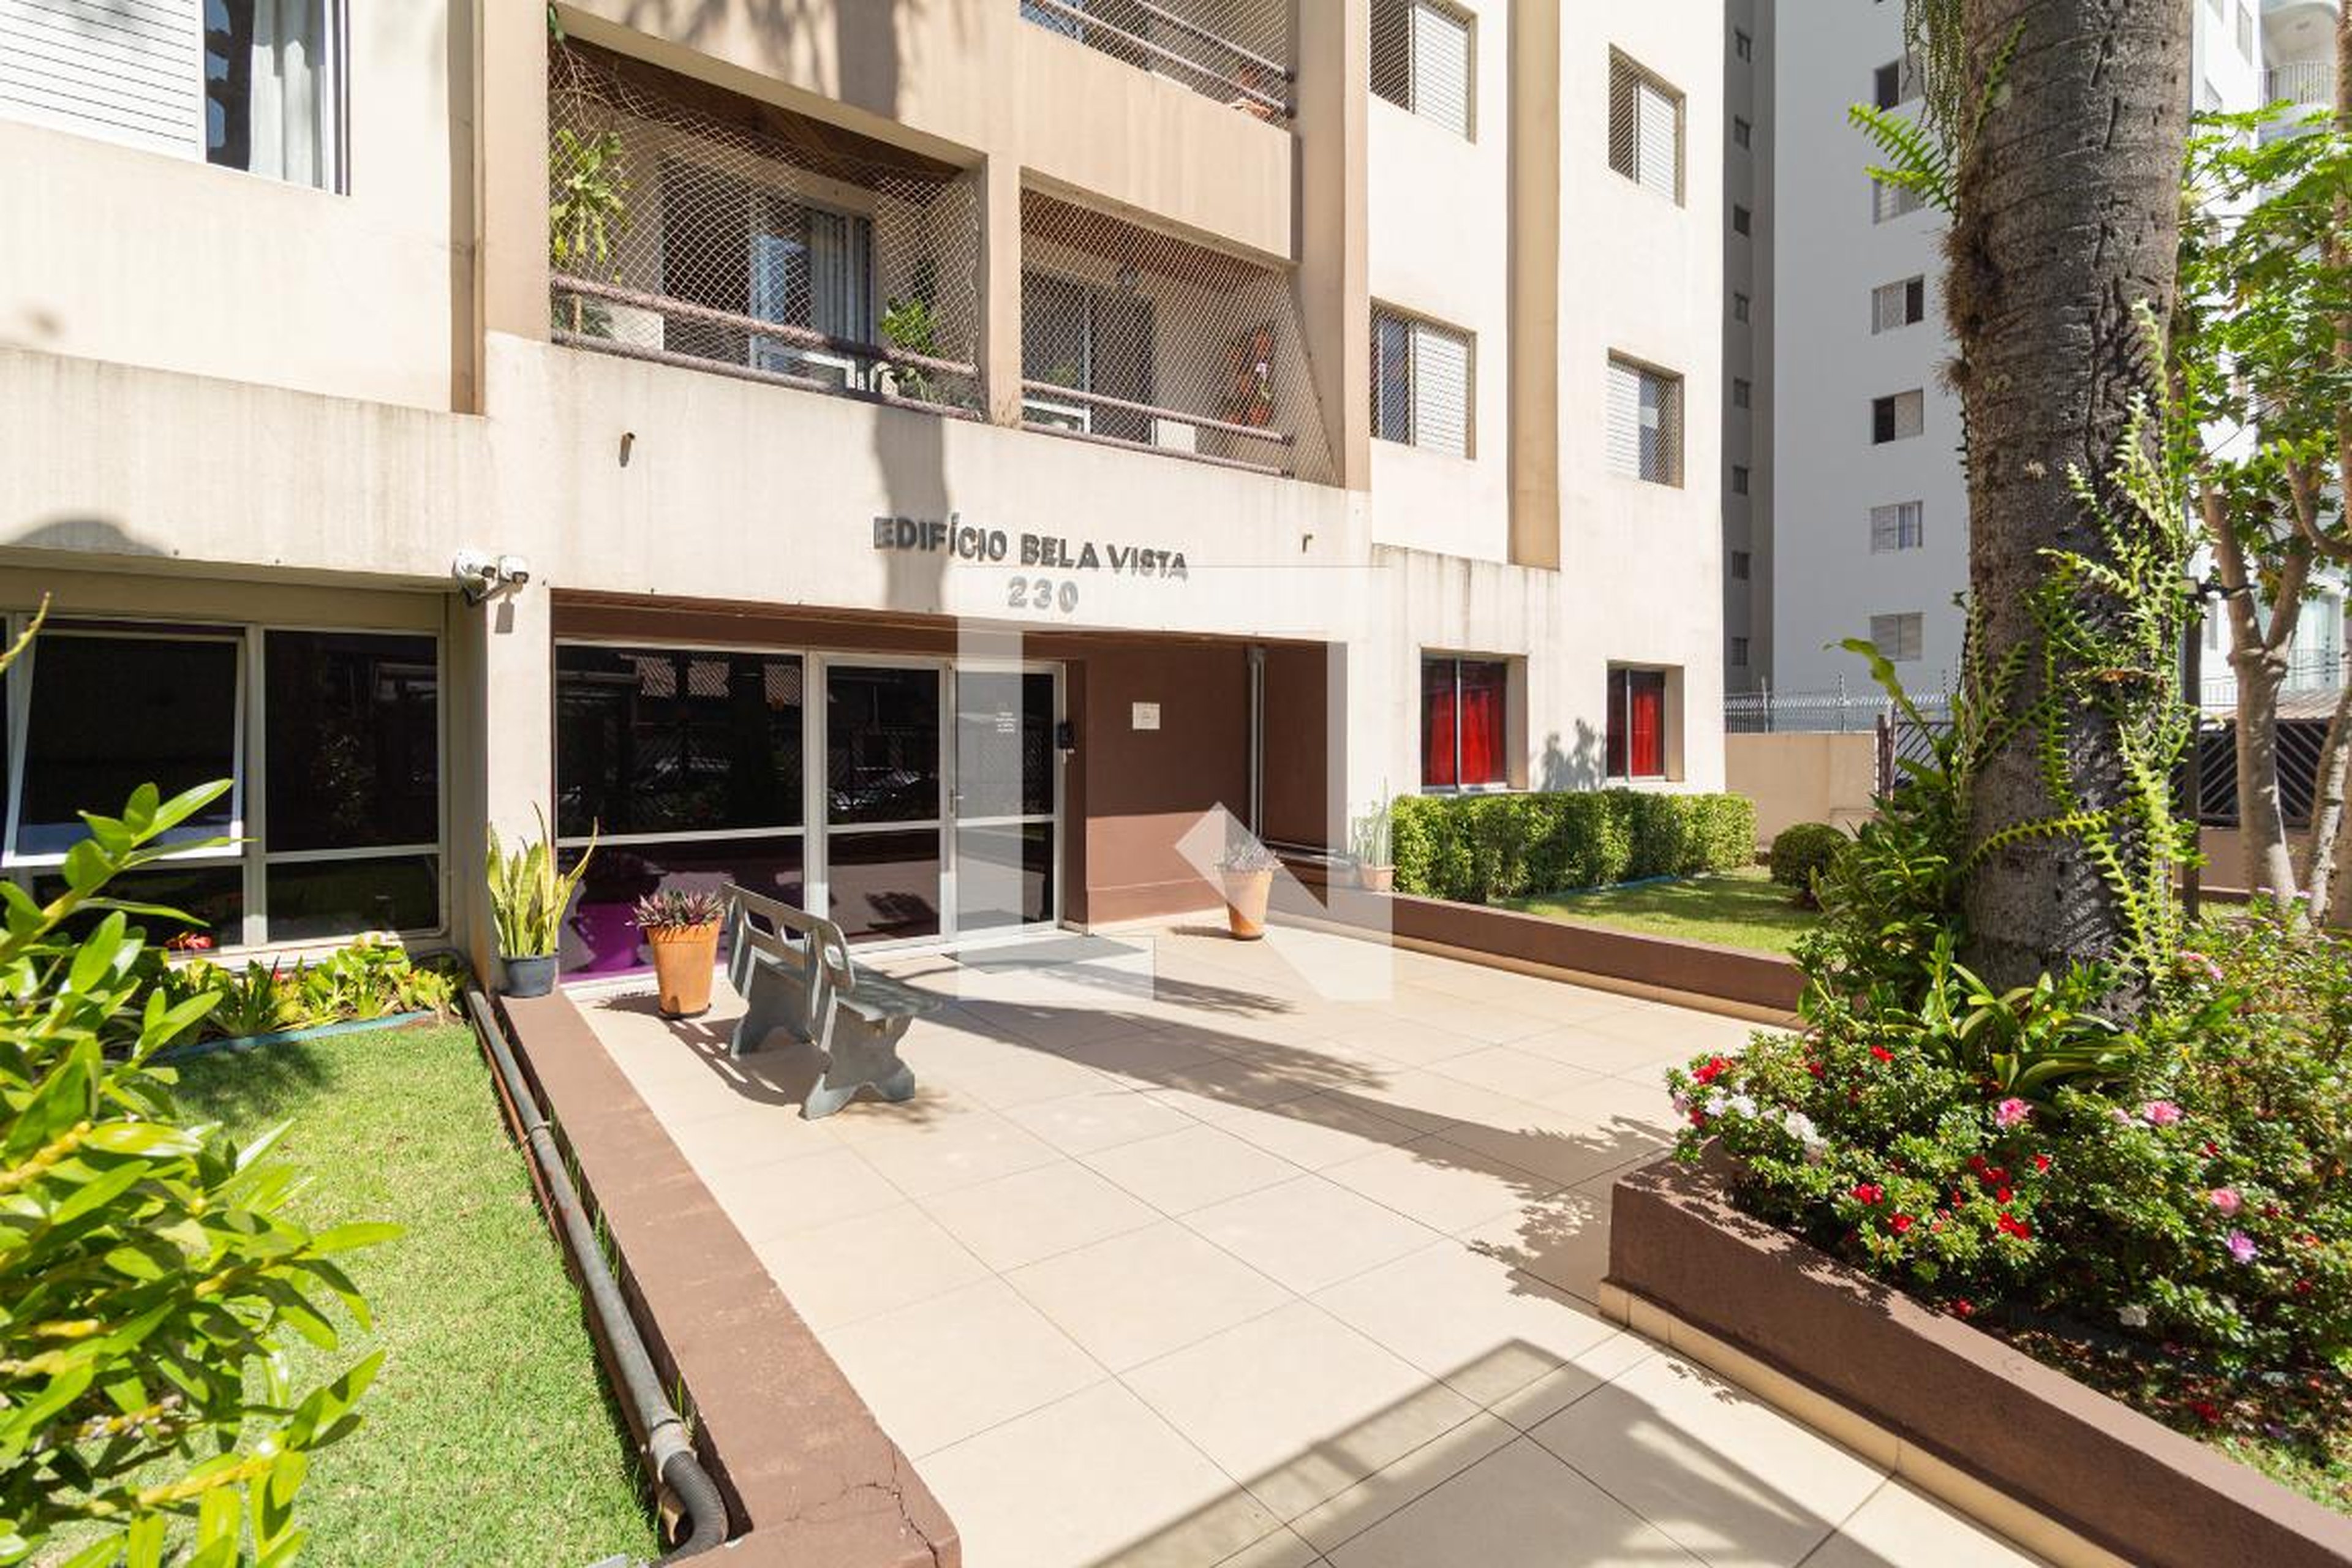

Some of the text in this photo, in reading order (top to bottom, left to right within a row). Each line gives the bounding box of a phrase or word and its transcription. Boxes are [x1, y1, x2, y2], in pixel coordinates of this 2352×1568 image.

[873, 513, 1189, 581] EDIFÍCIO BELA VISTA
[1008, 576, 1079, 612] 230
